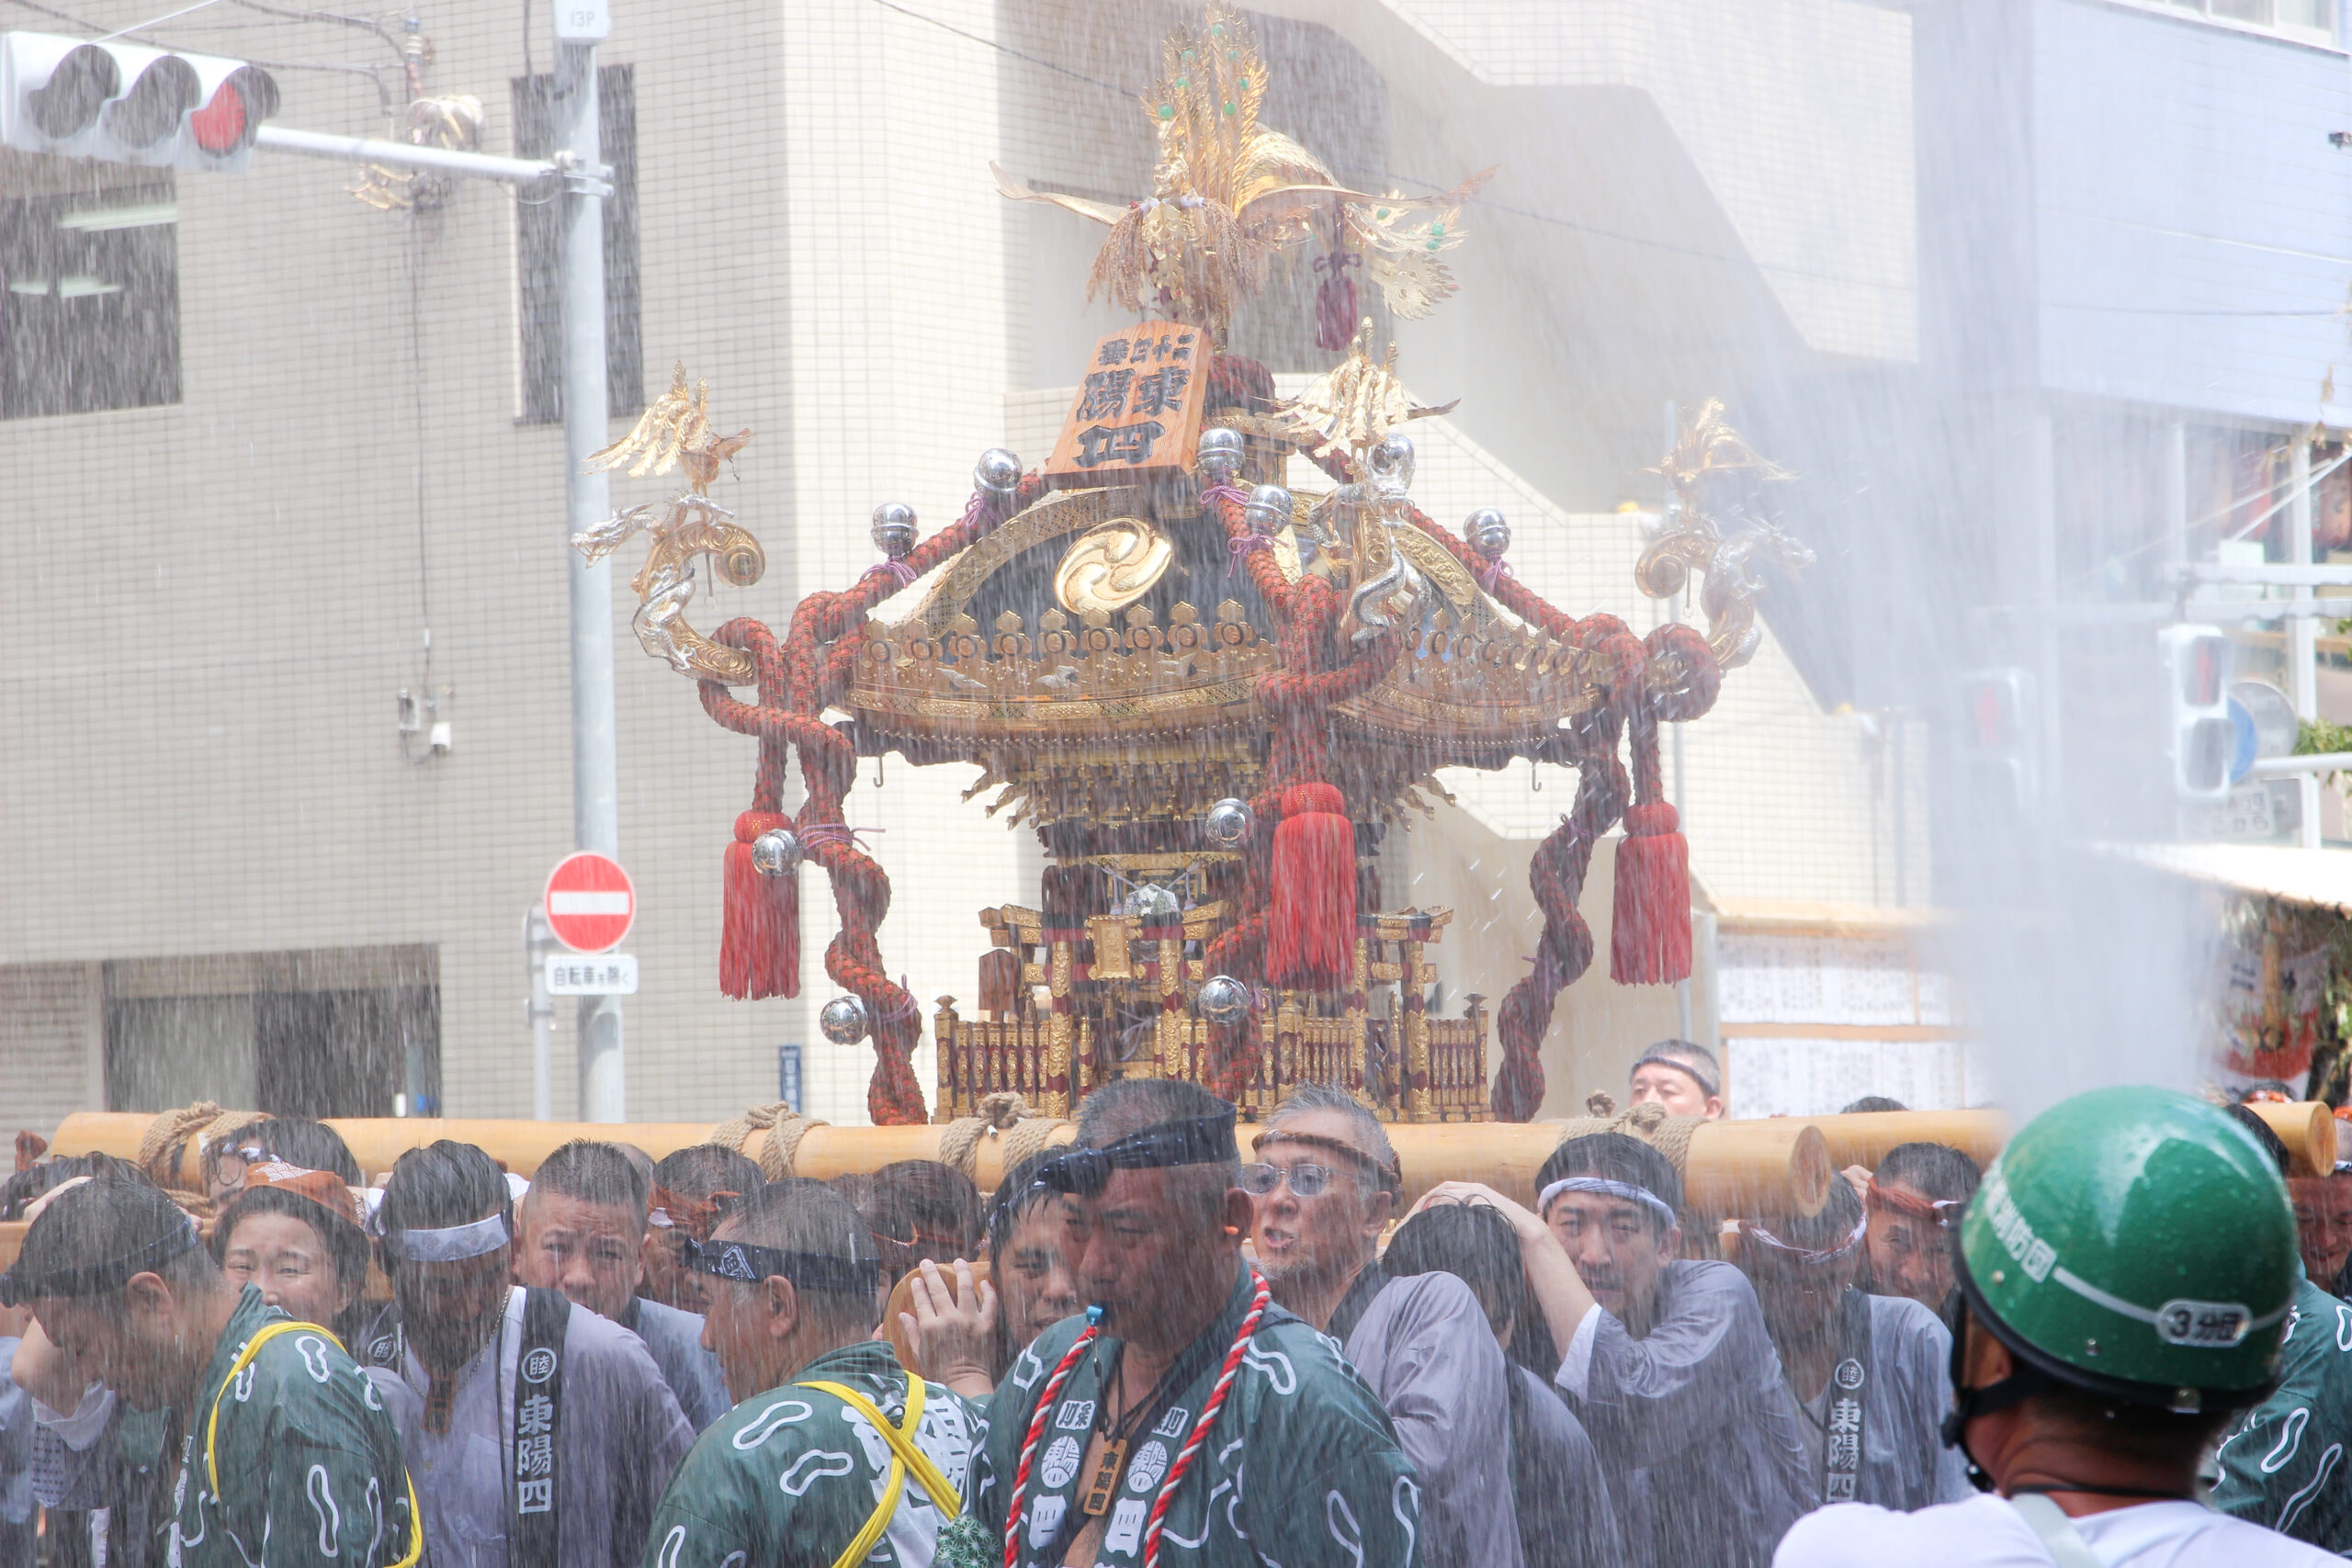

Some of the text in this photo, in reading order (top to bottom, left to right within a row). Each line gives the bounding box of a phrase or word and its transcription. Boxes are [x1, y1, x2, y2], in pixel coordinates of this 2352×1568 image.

[553, 964, 629, 987] 自転車を除く
[517, 1354, 553, 1514] 睦 東陽四
[1826, 1398, 1861, 1503] 東陽四
